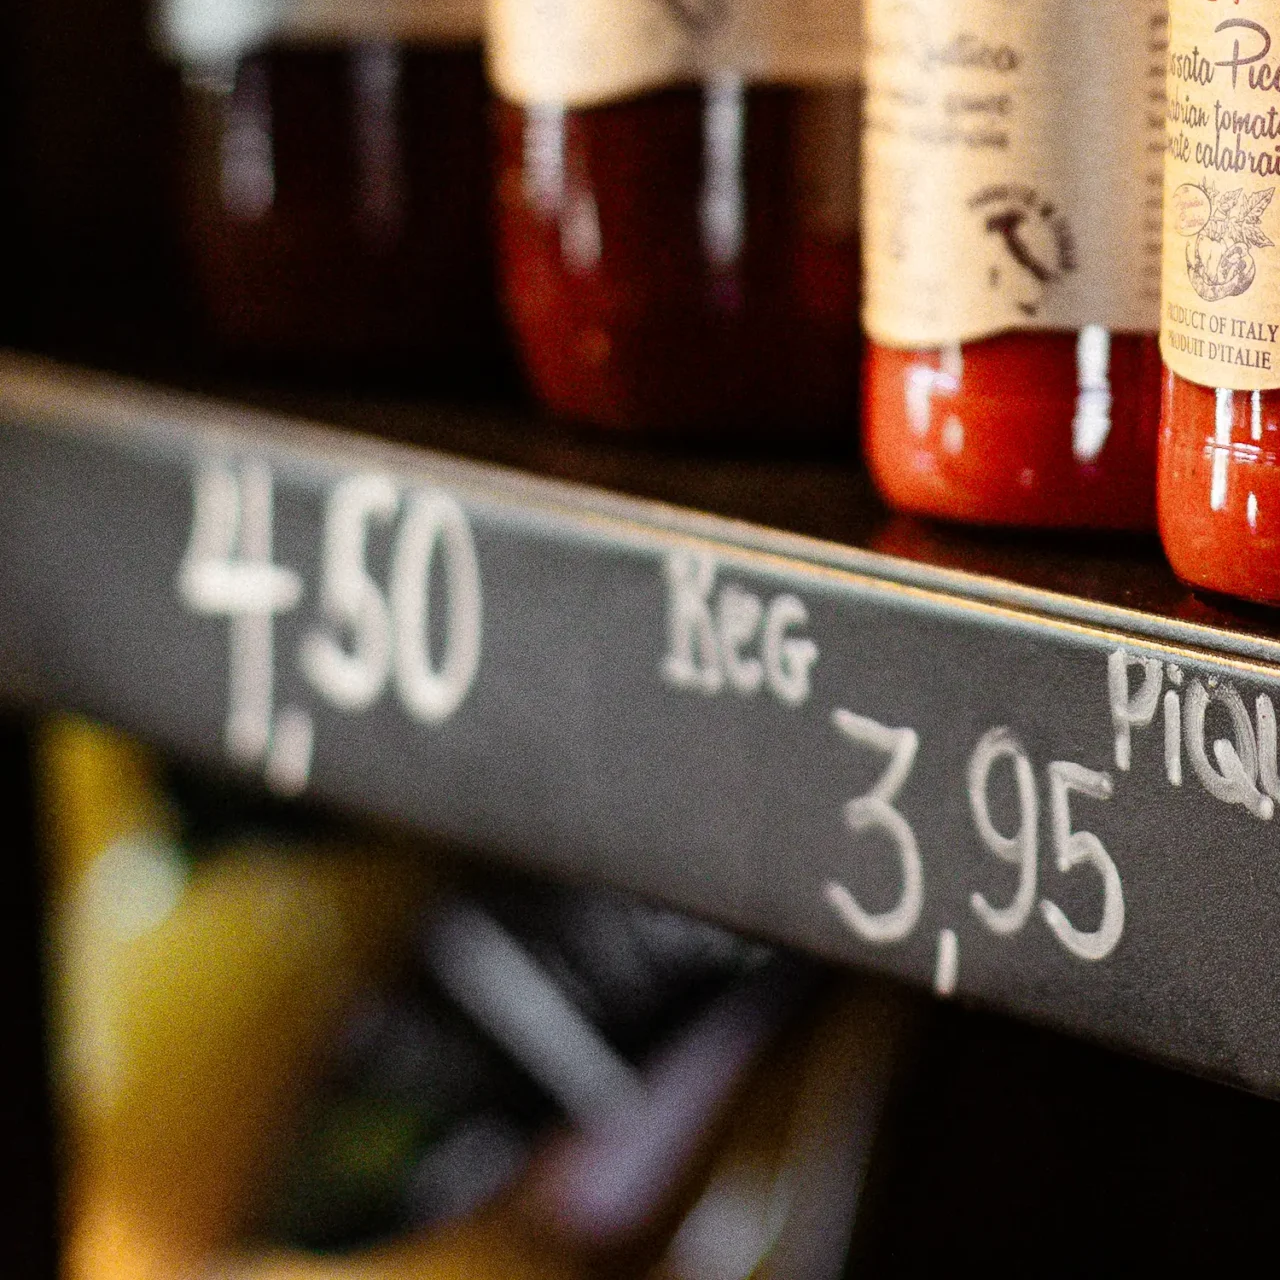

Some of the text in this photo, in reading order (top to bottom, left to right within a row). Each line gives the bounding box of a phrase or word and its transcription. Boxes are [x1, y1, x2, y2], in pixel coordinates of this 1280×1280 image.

[1166, 301, 1279, 343] PRODUCT OF ITALY
[1208, 341, 1272, 370] D'ITALIE
[179, 456, 484, 798] 4,50
[824, 708, 1126, 996] 3,95
